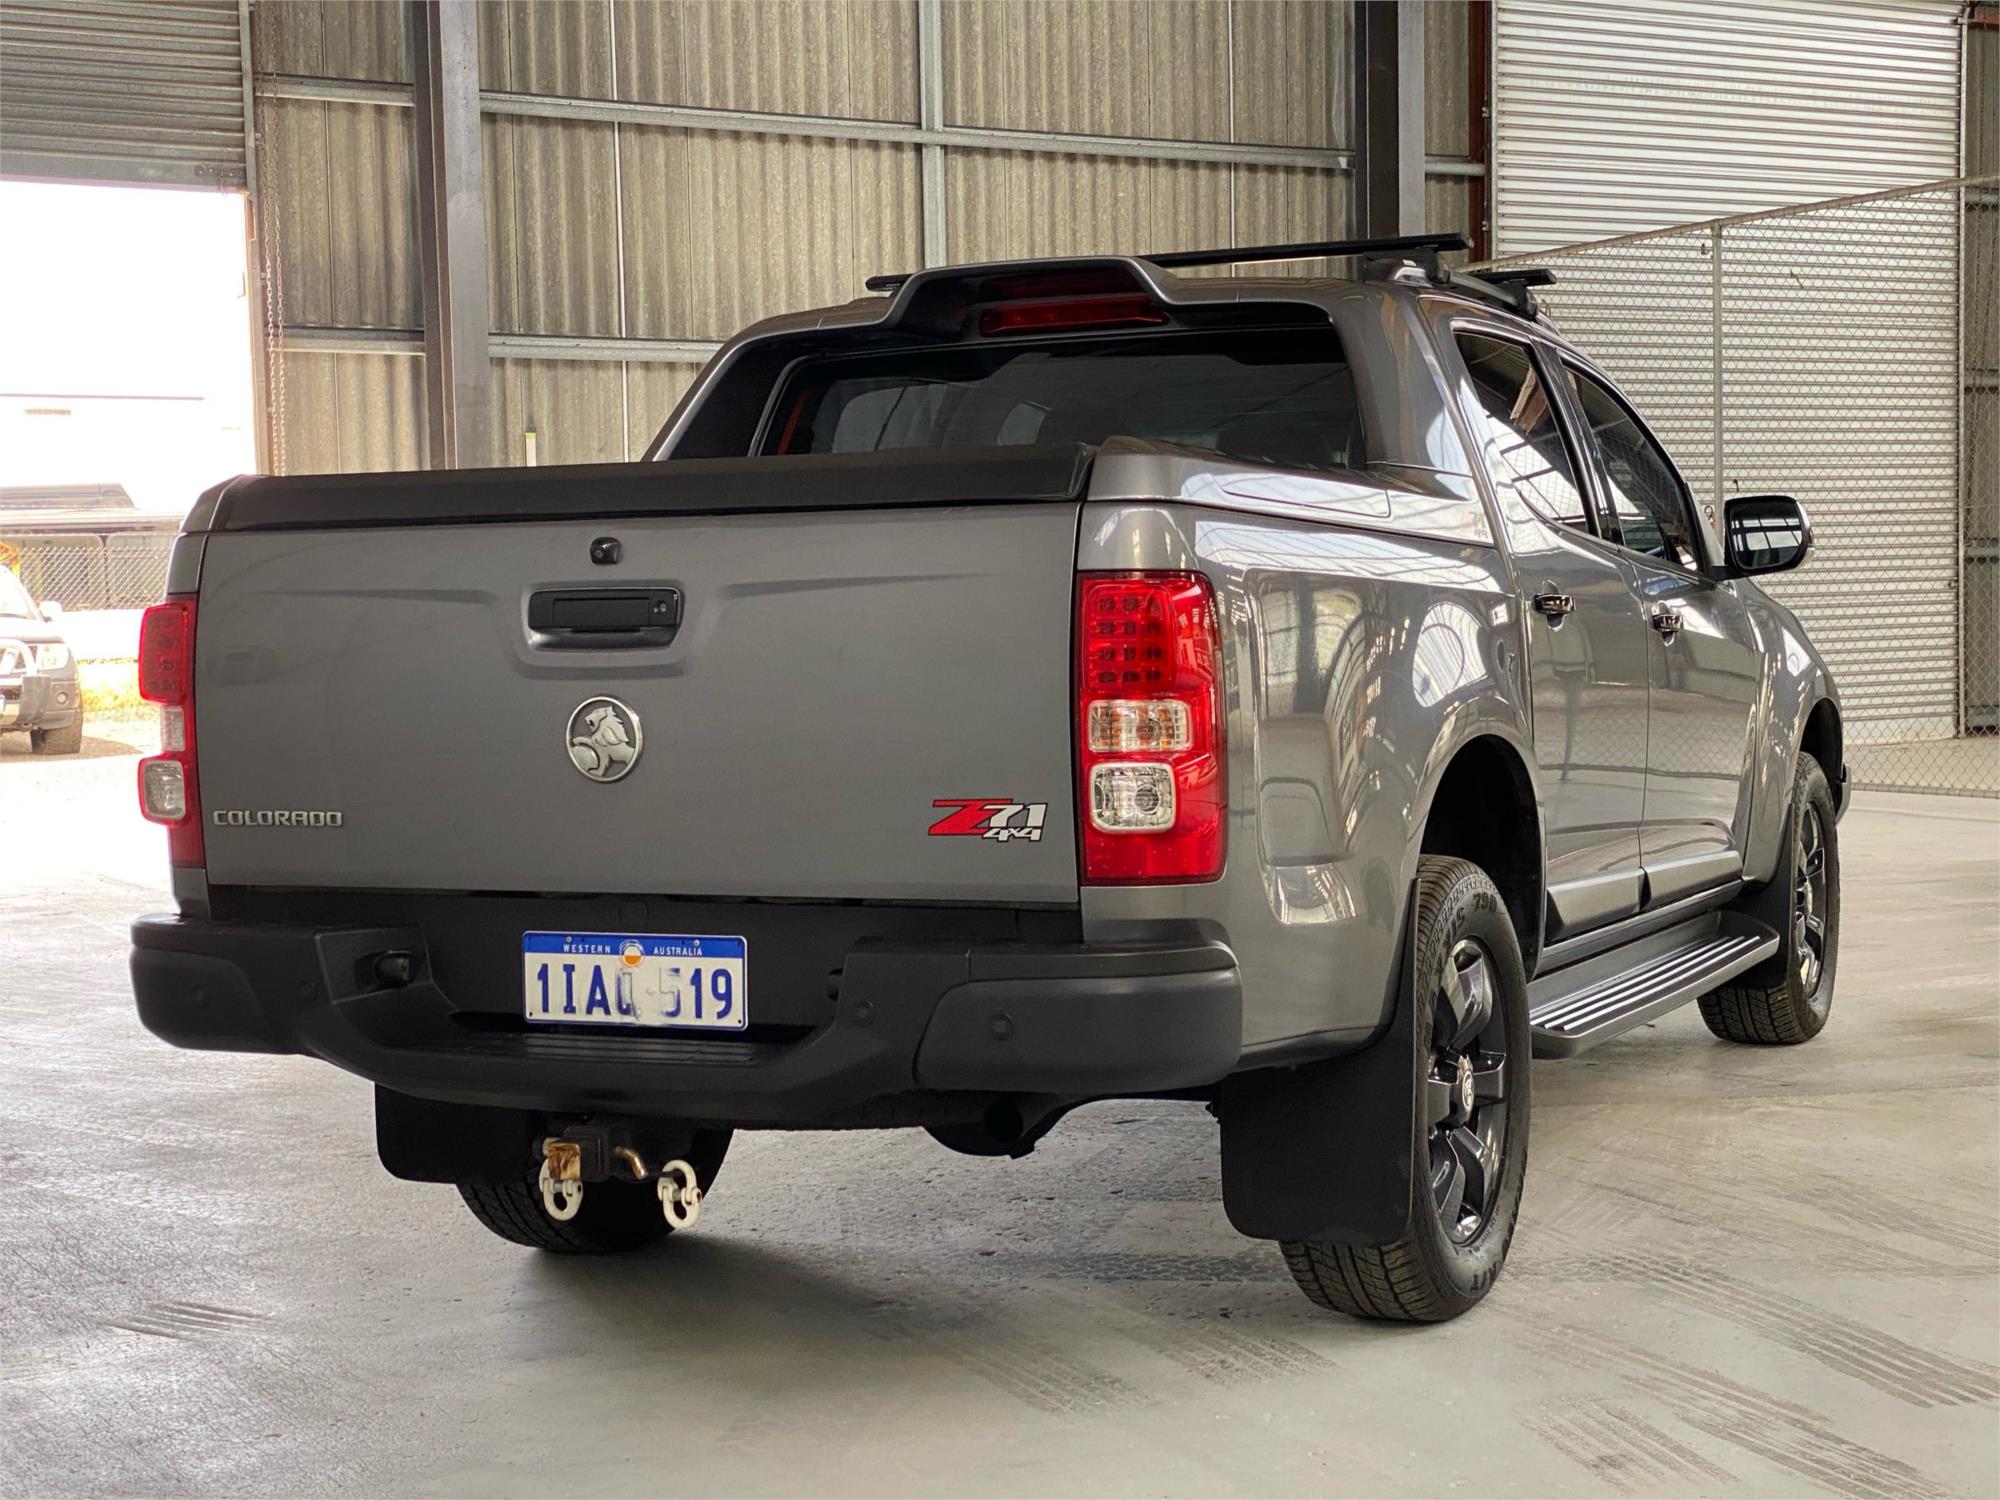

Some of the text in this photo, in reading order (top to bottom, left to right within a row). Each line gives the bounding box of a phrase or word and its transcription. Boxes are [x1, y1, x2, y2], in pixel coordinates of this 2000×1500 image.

[212, 810, 343, 827] COLORADO
[928, 798, 1048, 836] Z71
[563, 944, 703, 956] WESTERN AUSTRALIA
